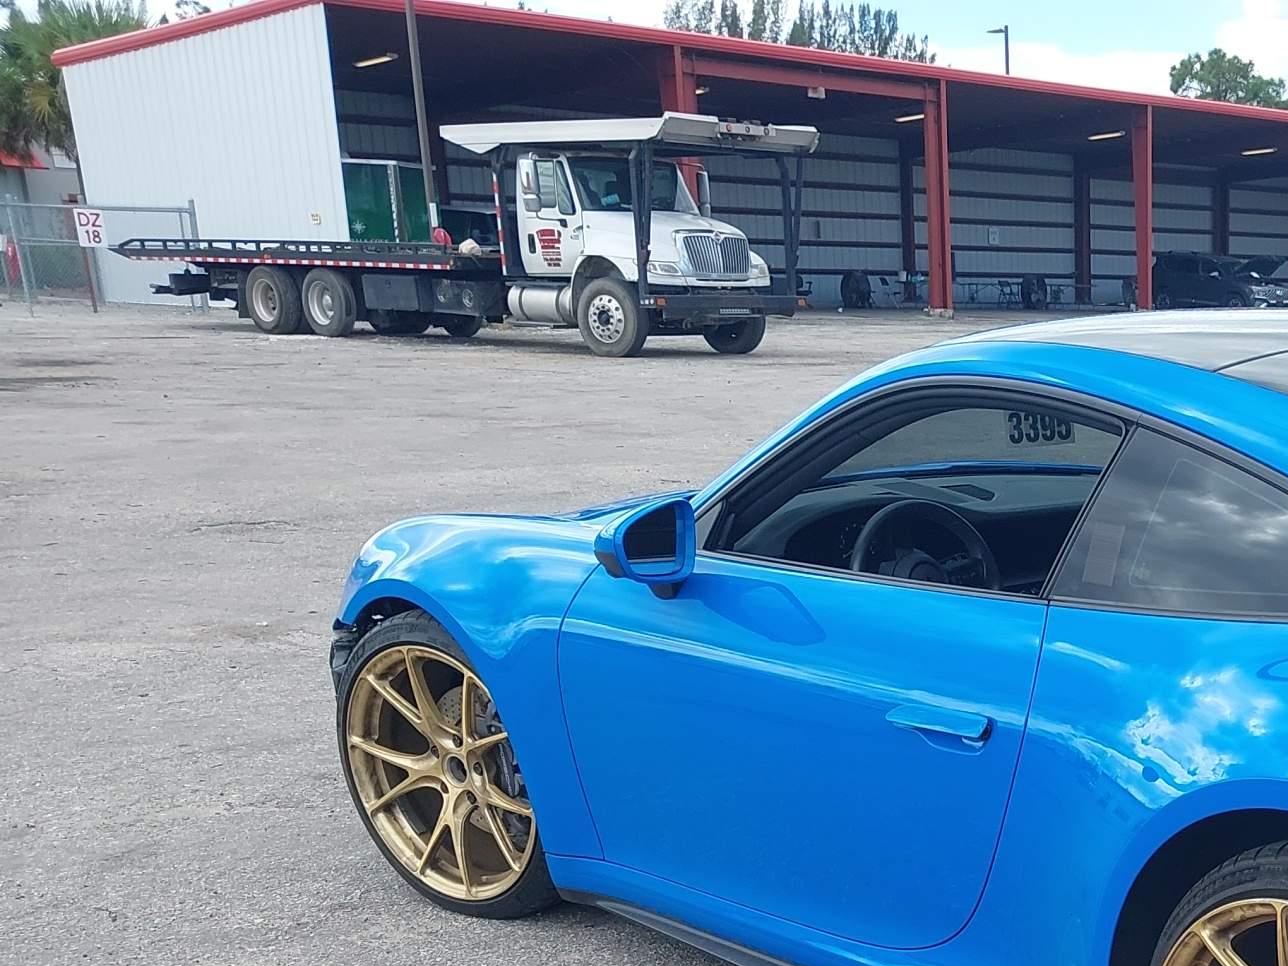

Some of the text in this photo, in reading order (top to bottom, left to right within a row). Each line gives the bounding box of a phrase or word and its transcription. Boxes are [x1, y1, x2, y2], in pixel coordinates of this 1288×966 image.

[77, 212, 102, 227] DZ
[85, 230, 102, 244] 18
[1008, 412, 1072, 444] 3395
